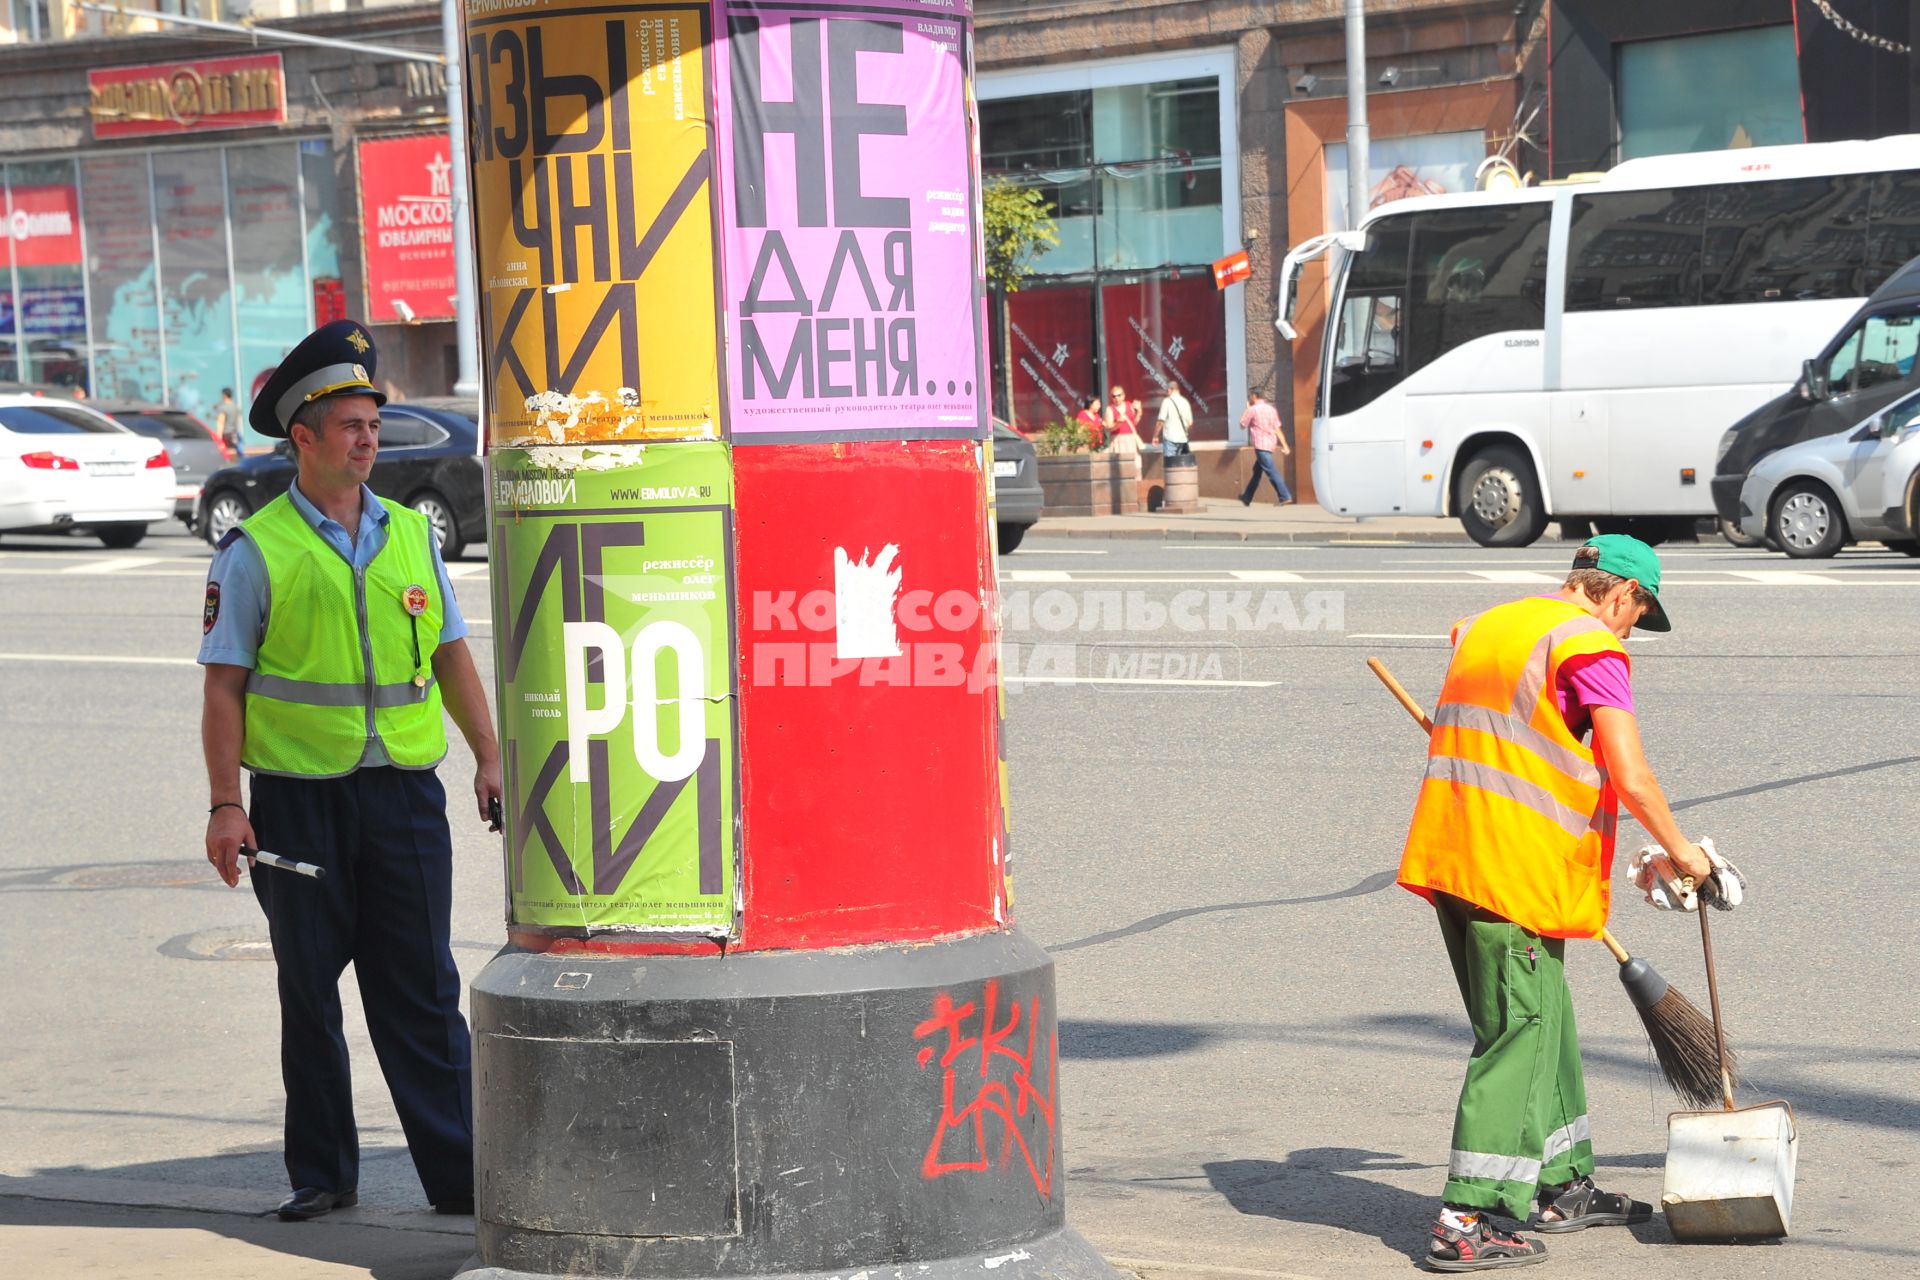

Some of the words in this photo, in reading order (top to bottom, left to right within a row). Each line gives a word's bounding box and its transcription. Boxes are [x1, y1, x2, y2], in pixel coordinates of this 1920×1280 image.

[729, 16, 911, 228] НЕ
[509, 149, 711, 285] ЧНИ
[506, 261, 527, 272] анна
[739, 230, 915, 317] ДЛЯ
[485, 283, 641, 413] КИ
[741, 317, 973, 400] МЕНЯ...
[743, 404, 831, 417] художественный
[642, 555, 714, 573] режиссёр
[682, 575, 714, 585] олег
[631, 591, 716, 602] меньшиков
[524, 688, 561, 702] николай
[563, 620, 706, 783] РО
[531, 708, 562, 718] гоголь
[508, 738, 723, 896] КИ
[642, 901, 662, 909] олег
